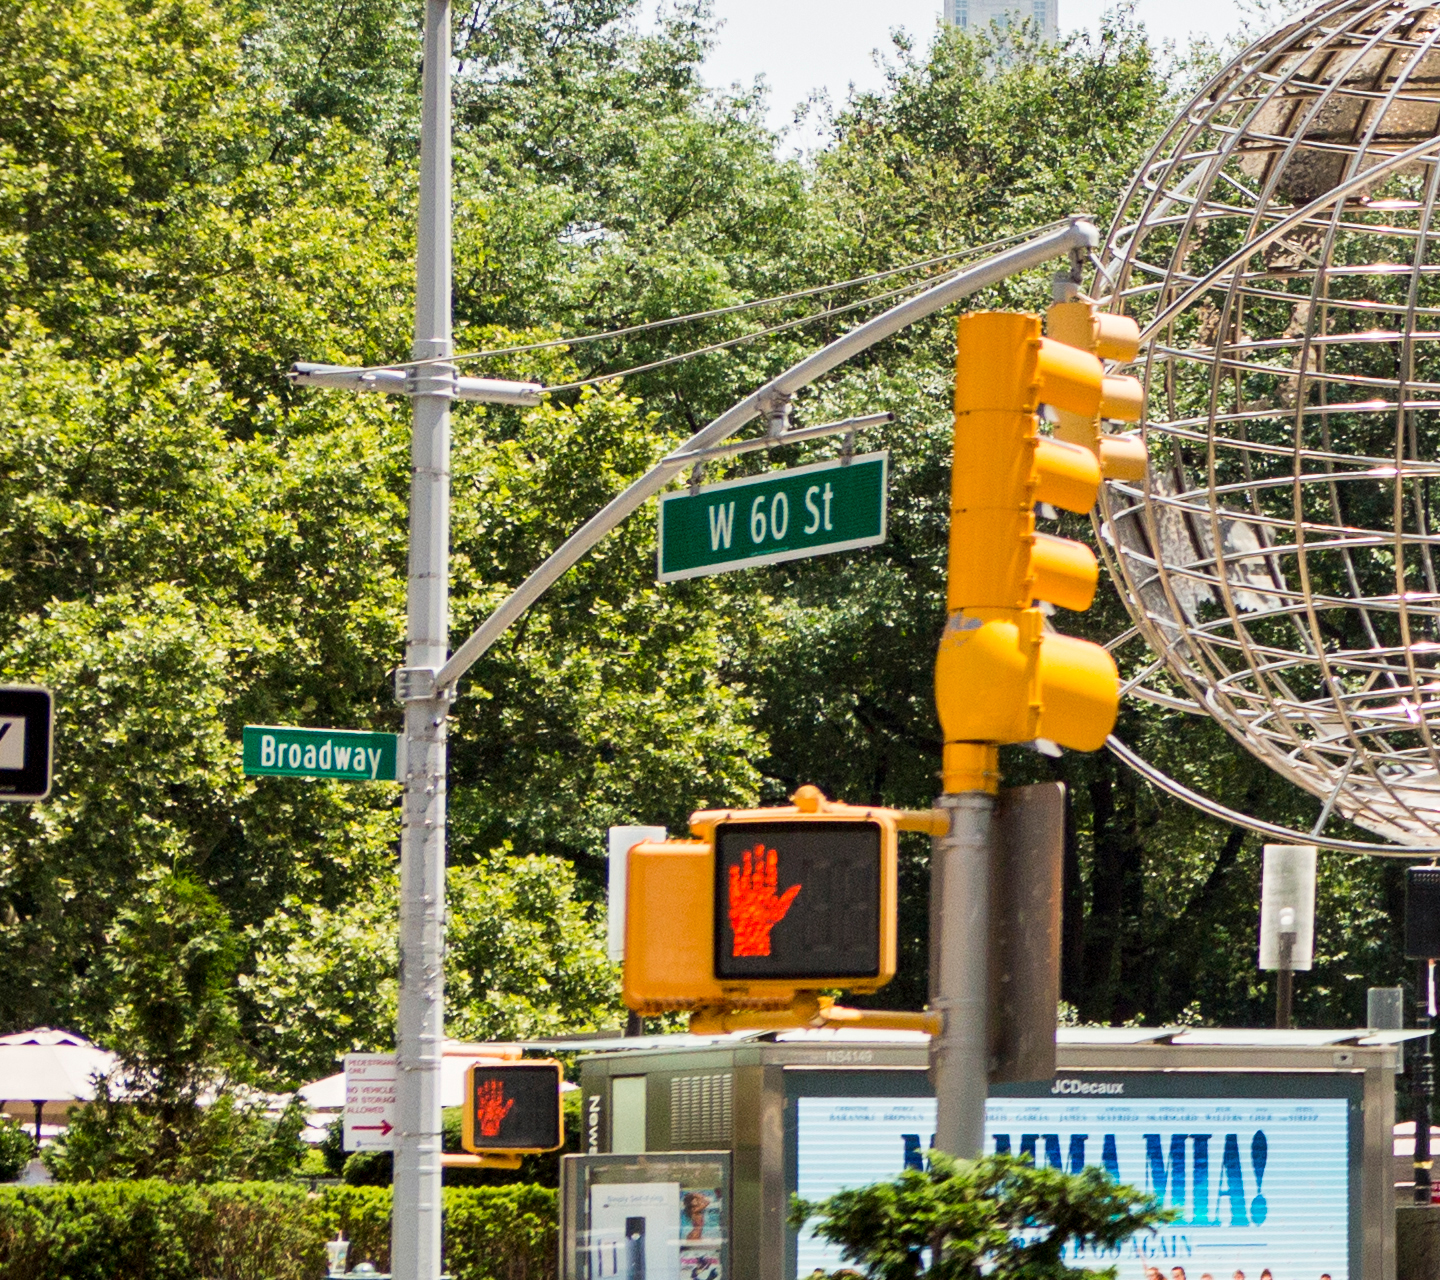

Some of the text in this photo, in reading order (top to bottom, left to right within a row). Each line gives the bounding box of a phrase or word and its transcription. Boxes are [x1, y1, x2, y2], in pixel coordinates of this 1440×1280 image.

[708, 482, 834, 552] W 60 St
[260, 734, 383, 780] Broadway
[362, 1086, 396, 1095] VEHICLE
[1051, 1079, 1124, 1095] JCDecaux
[1130, 1234, 1193, 1260] AGAIN
